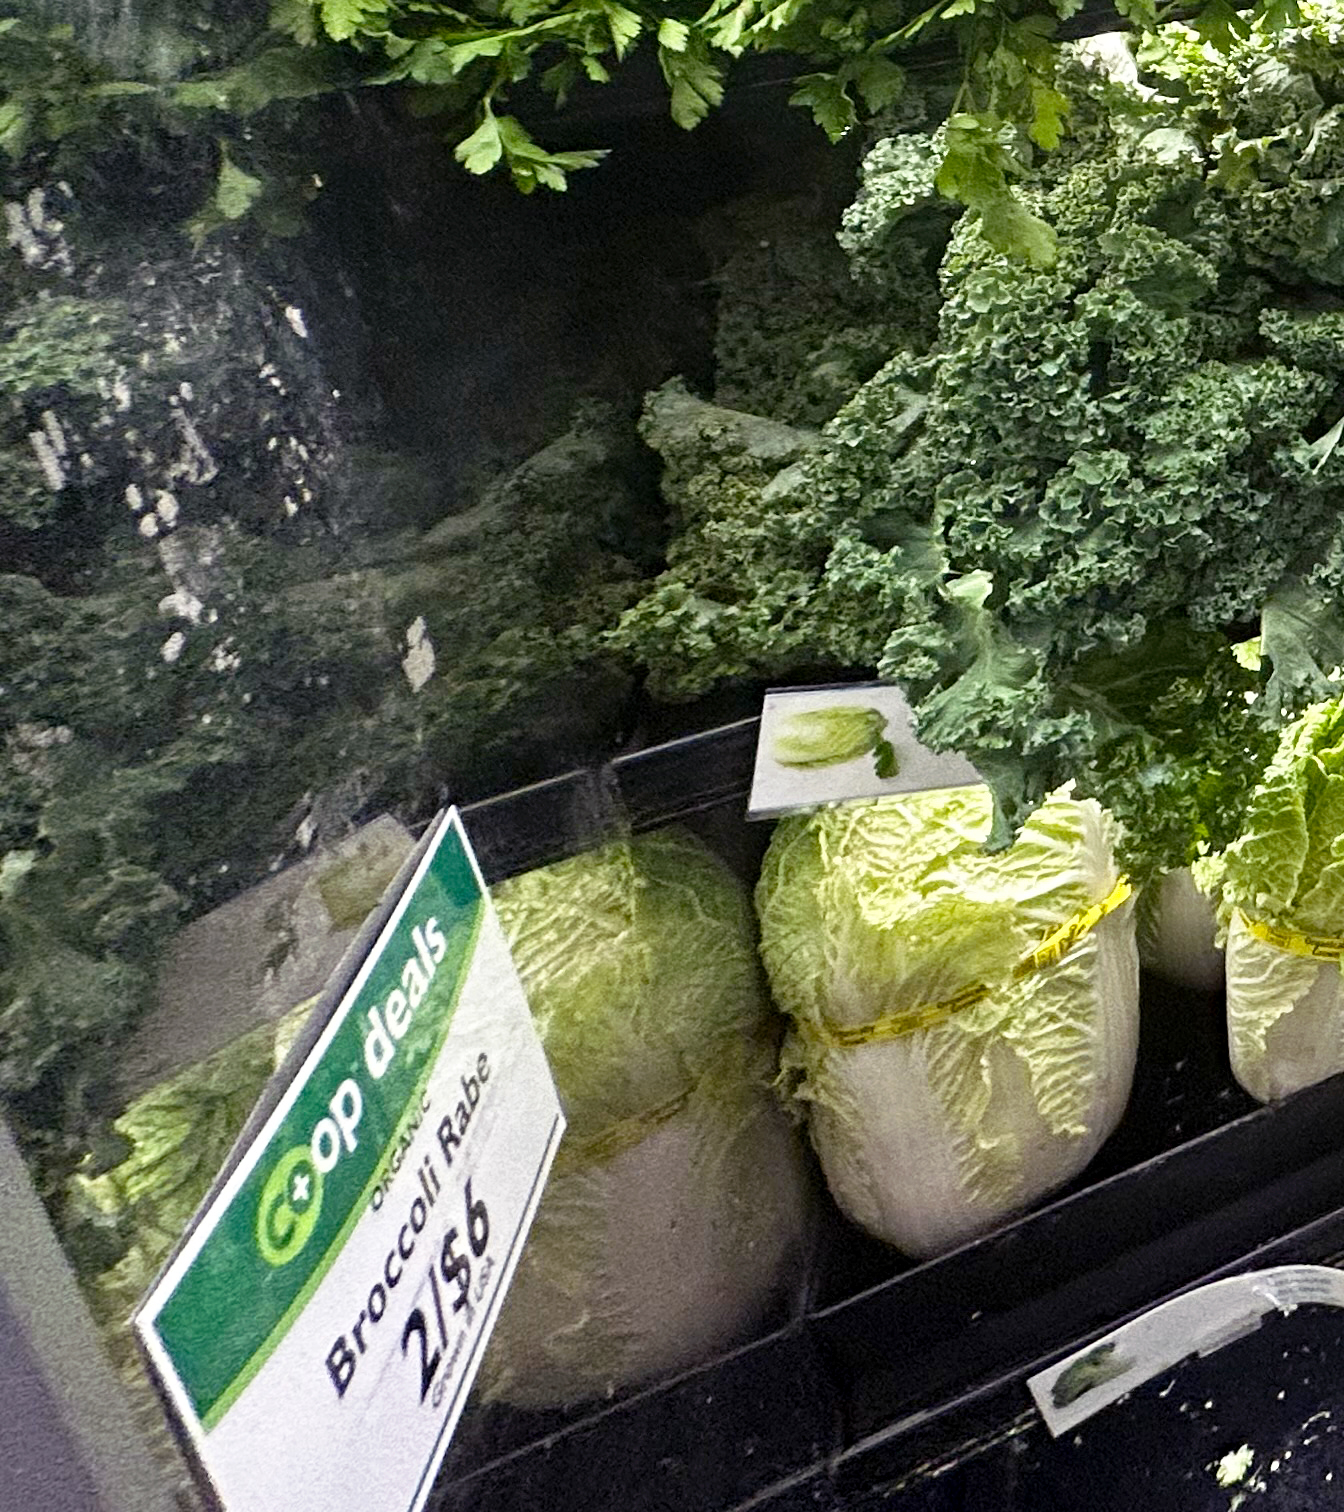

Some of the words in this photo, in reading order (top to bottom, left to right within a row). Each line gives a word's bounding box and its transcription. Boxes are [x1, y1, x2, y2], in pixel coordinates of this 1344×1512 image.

[363, 915, 447, 1080] deals
[325, 1156, 439, 1400] Broccoli
[436, 1051, 491, 1165] Rabe
[402, 1175, 489, 1404] 2/$6
